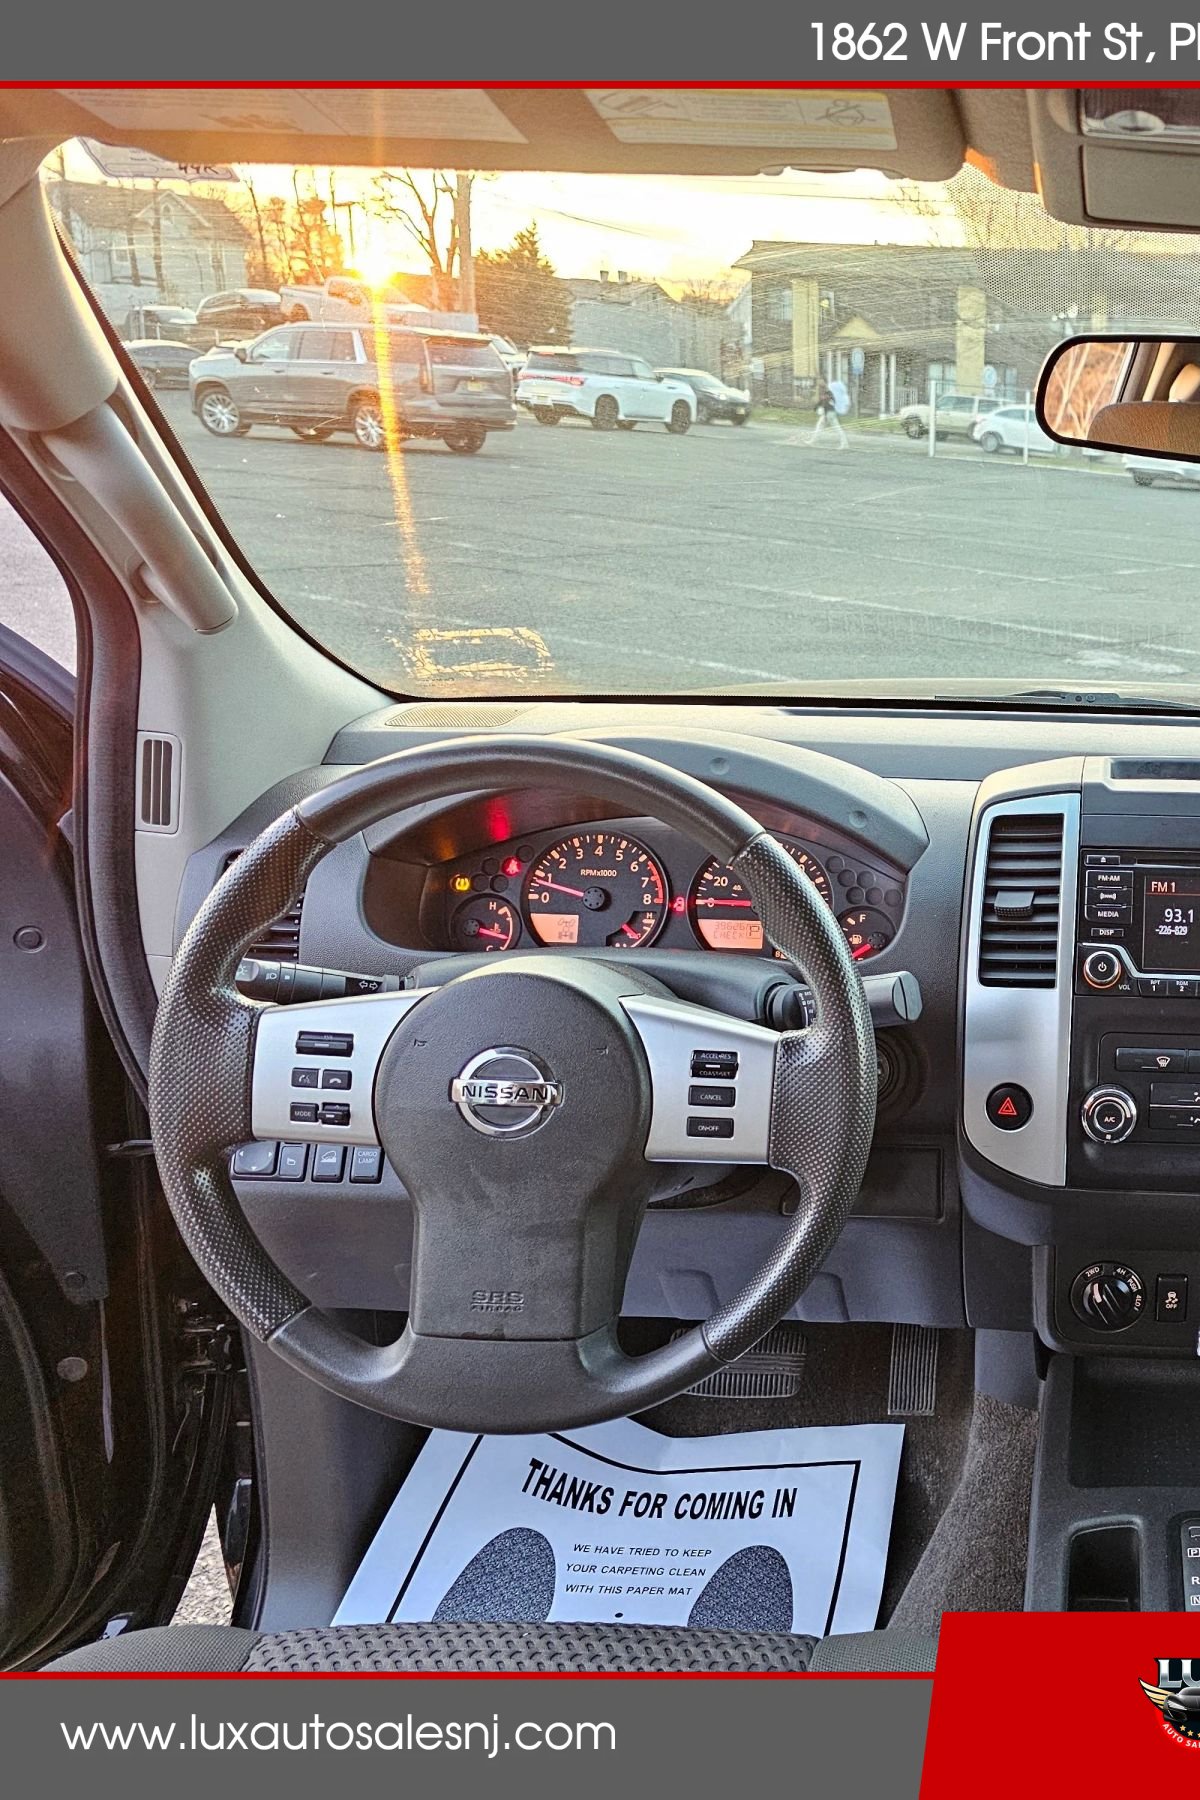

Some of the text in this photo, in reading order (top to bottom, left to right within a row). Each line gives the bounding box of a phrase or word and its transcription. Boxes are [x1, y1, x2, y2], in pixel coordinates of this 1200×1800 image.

[575, 849, 584, 860] 3
[594, 846, 604, 857] 4
[615, 850, 624, 861] 5
[559, 859, 567, 869] 2
[630, 862, 639, 872] 6
[641, 877, 648, 888] 7
[713, 876, 728, 887] 20
[1151, 881, 1176, 893] FM 1
[541, 892, 549, 903] 0
[643, 893, 651, 905] 8
[489, 901, 497, 910] H
[859, 914, 867, 923] F
[1164, 908, 1194, 923] 93.1
[461, 1085, 549, 1100] NISSAN
[1085, 1266, 1100, 1278] 2WD
[472, 1289, 524, 1304] SRS
[521, 1457, 798, 1520] THANKS FOR COMING IN
[573, 1543, 712, 1558] WE HAVE TRIED TO KEEP
[566, 1563, 706, 1577] YOUR CARPETING CLEAN
[1191, 1576, 1200, 1585] R
[565, 1584, 693, 1596] WITH THIS PAPER MAT
